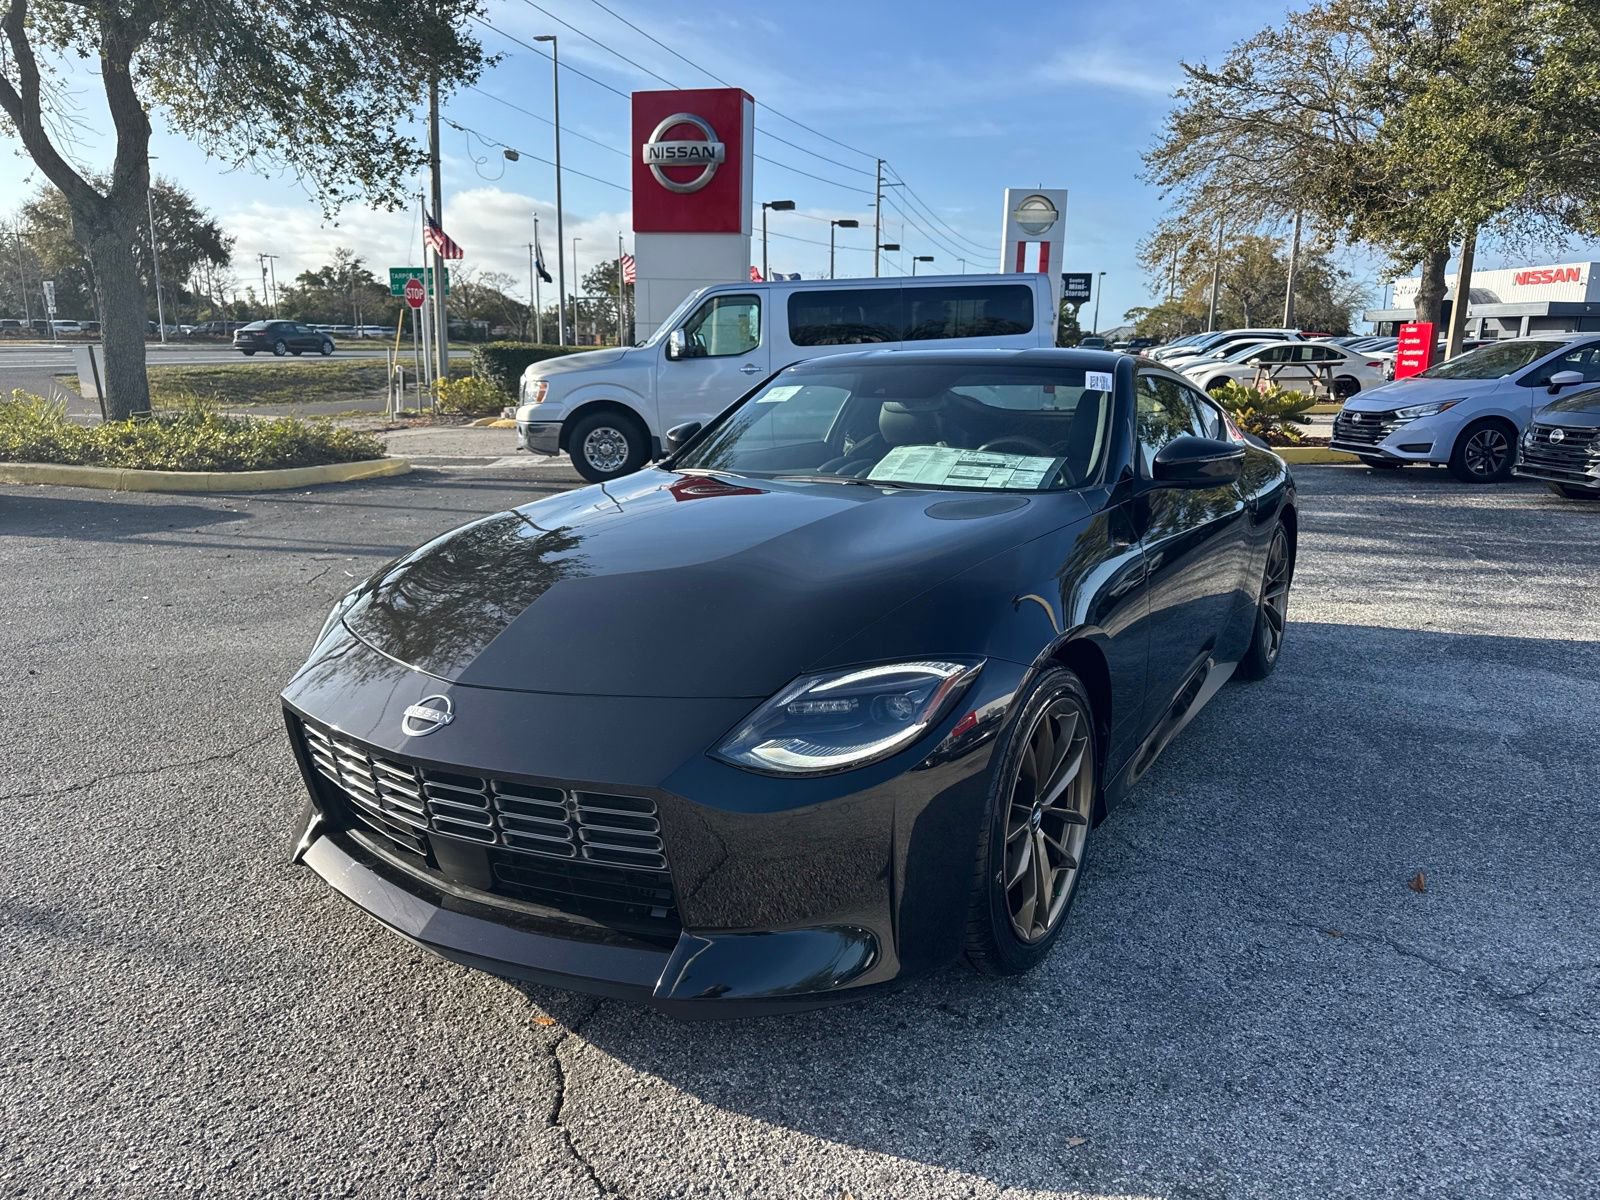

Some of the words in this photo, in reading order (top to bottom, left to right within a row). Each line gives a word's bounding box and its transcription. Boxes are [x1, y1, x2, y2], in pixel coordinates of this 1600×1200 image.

[649, 146, 715, 159] NISSAN
[1512, 267, 1581, 286] NISSAN
[406, 288, 424, 299] STOP
